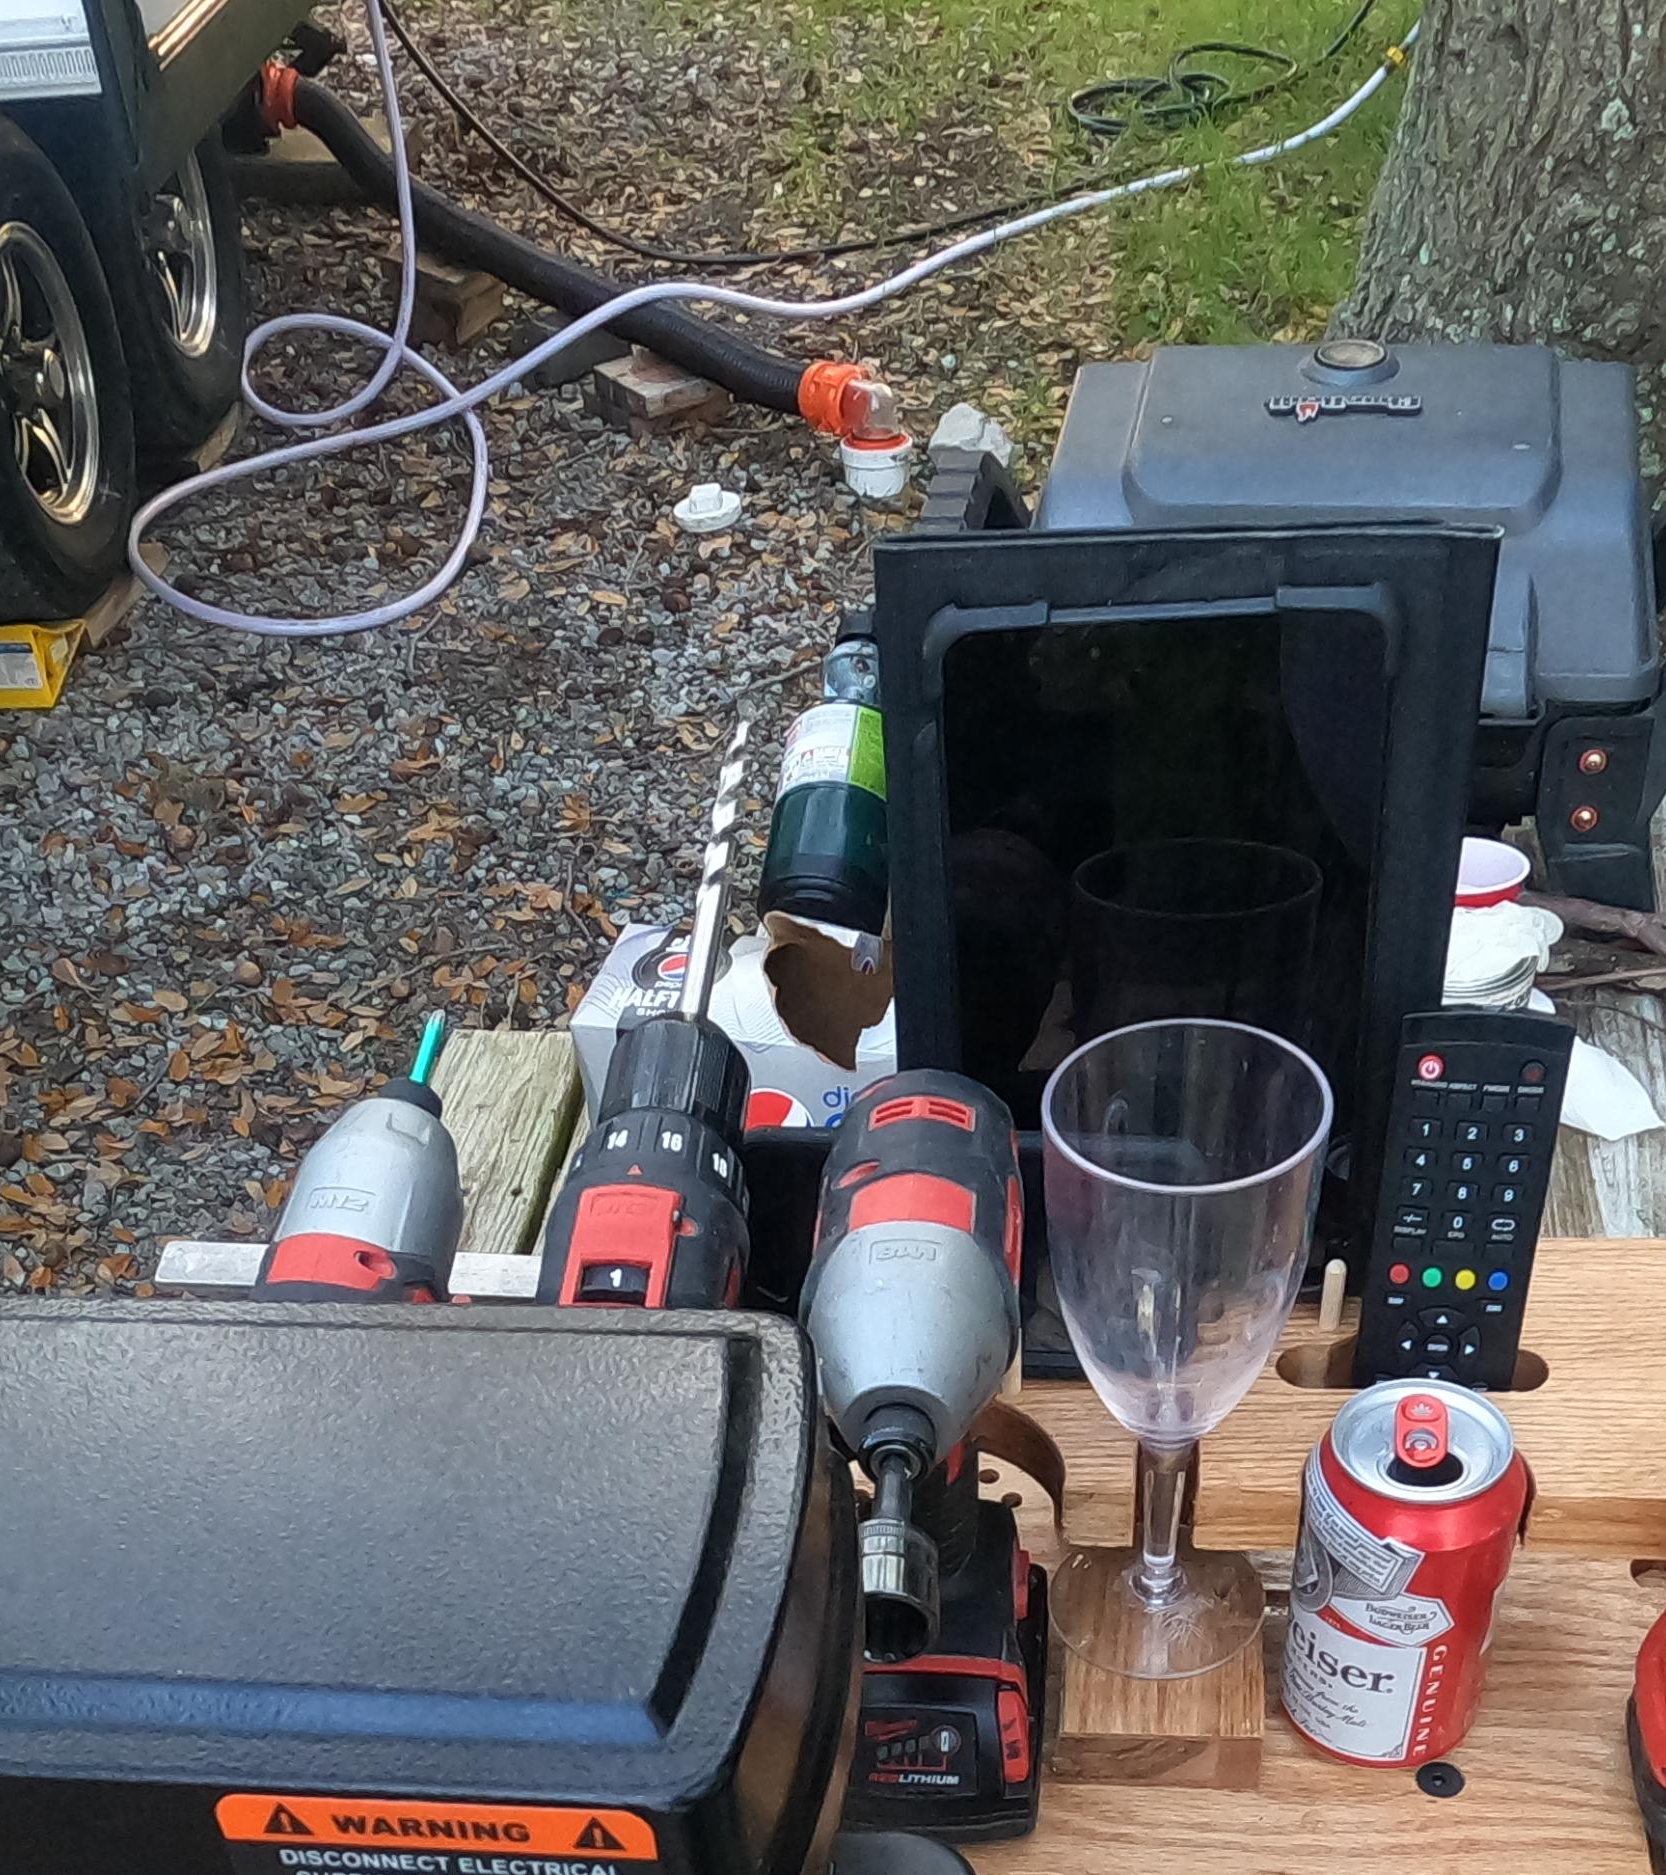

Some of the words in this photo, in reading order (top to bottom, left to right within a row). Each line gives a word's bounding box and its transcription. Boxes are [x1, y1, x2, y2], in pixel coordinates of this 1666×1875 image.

[609, 987, 681, 1009] HALFT
[822, 1086, 850, 1107] di
[1422, 1122, 1431, 1137] 1
[1466, 1126, 1479, 1141] 2
[1513, 1128, 1525, 1143] 3
[607, 1129, 629, 1150] 14
[661, 1131, 683, 1152] 16
[712, 1152, 728, 1179] 18
[1415, 1153, 1426, 1167] 4
[1462, 1157, 1473, 1171] 5
[1508, 1159, 1519, 1173] 6
[1412, 1182, 1422, 1196] 7
[1457, 1186, 1468, 1200] 8
[1503, 1188, 1515, 1202] 9
[1452, 1216, 1464, 1230] 0
[609, 1268, 623, 1288] 1
[1292, 1620, 1396, 1695] eiser.
[1412, 1644, 1448, 1758] GENUINE
[333, 1813, 531, 1843] WARNING
[279, 1849, 450, 1874] DISCONNECT
